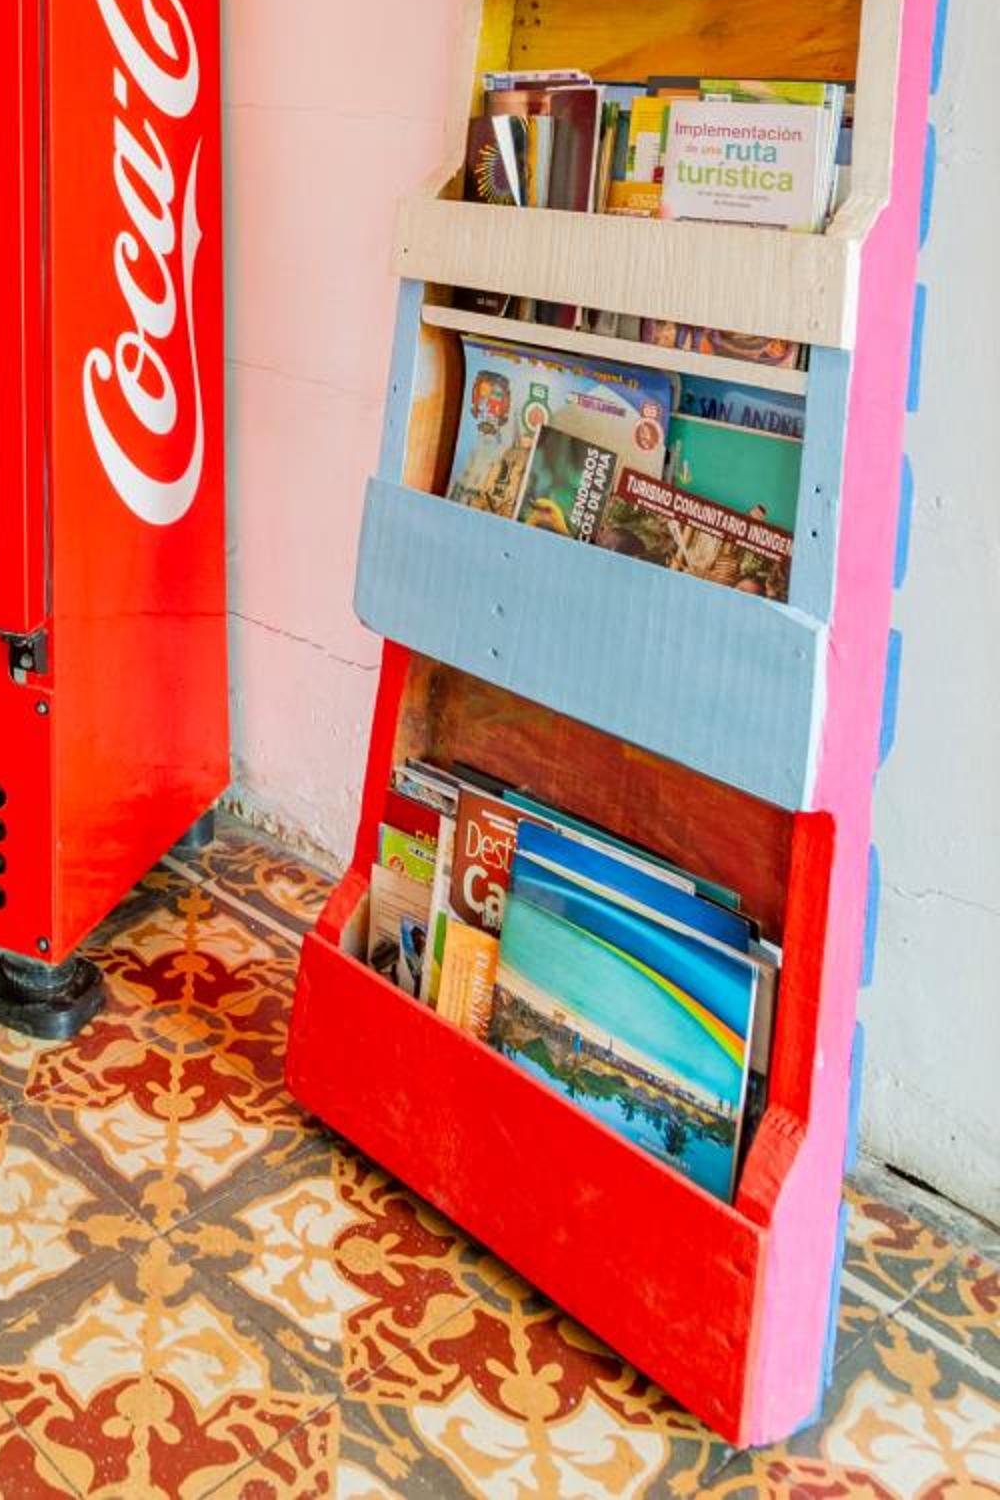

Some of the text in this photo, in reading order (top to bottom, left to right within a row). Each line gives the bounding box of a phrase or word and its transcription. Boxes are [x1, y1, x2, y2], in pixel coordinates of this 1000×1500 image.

[725, 141, 777, 163] ruta
[677, 160, 793, 192] turística
[570, 447, 599, 527] SENDEROS
[587, 490, 602, 512] DE
[627, 475, 673, 507] TURISMO
[673, 494, 748, 538] COMUNITARIO
